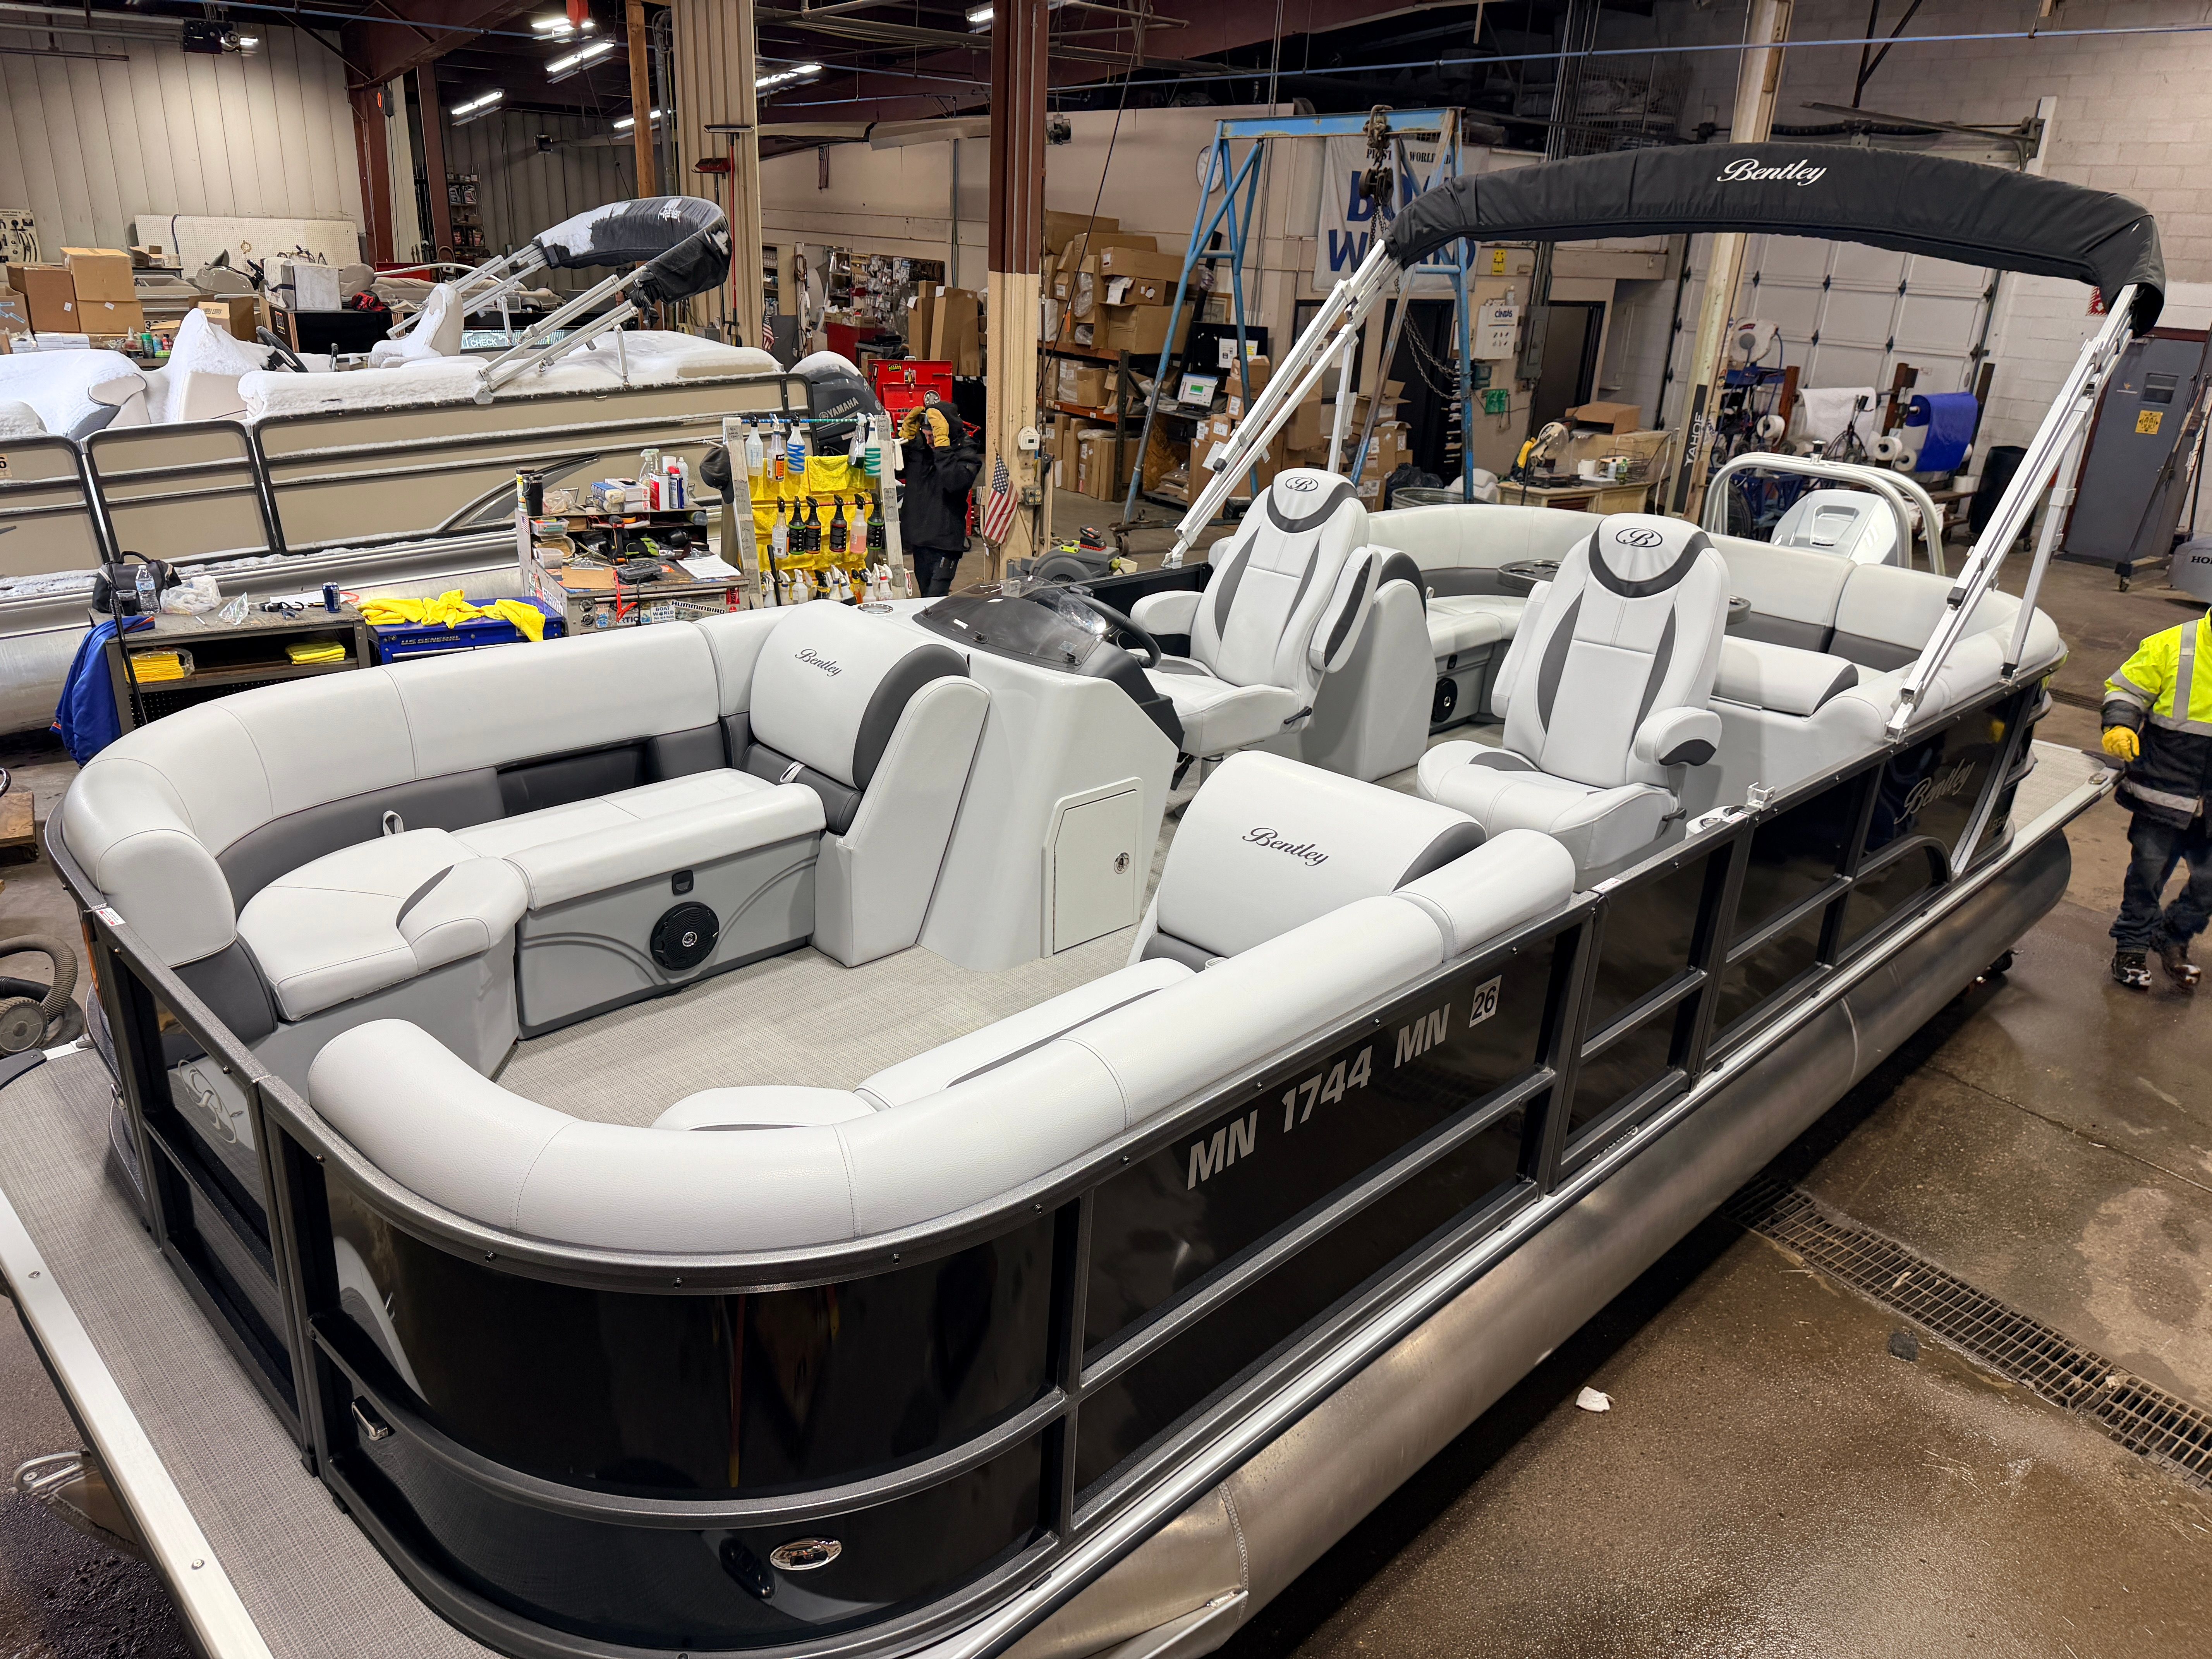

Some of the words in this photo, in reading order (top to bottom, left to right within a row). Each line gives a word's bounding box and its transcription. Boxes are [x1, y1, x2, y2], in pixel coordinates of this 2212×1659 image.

[1716, 158, 1827, 186] Bentley
[470, 338, 498, 347] CHECK
[827, 397, 859, 417] YAMAHA
[2191, 556, 2212, 564] HO
[672, 600, 725, 614] HUMMINBIRD
[417, 635, 460, 644] GENERAL
[795, 649, 842, 677] Bentley
[1893, 757, 1976, 825] Bentley
[1242, 827, 1329, 867] Bentley
[1471, 986, 1496, 1021] 26
[1187, 1109, 1258, 1191] MN
[1281, 1044, 1373, 1134] 1744
[1393, 1002, 1451, 1069] MN
